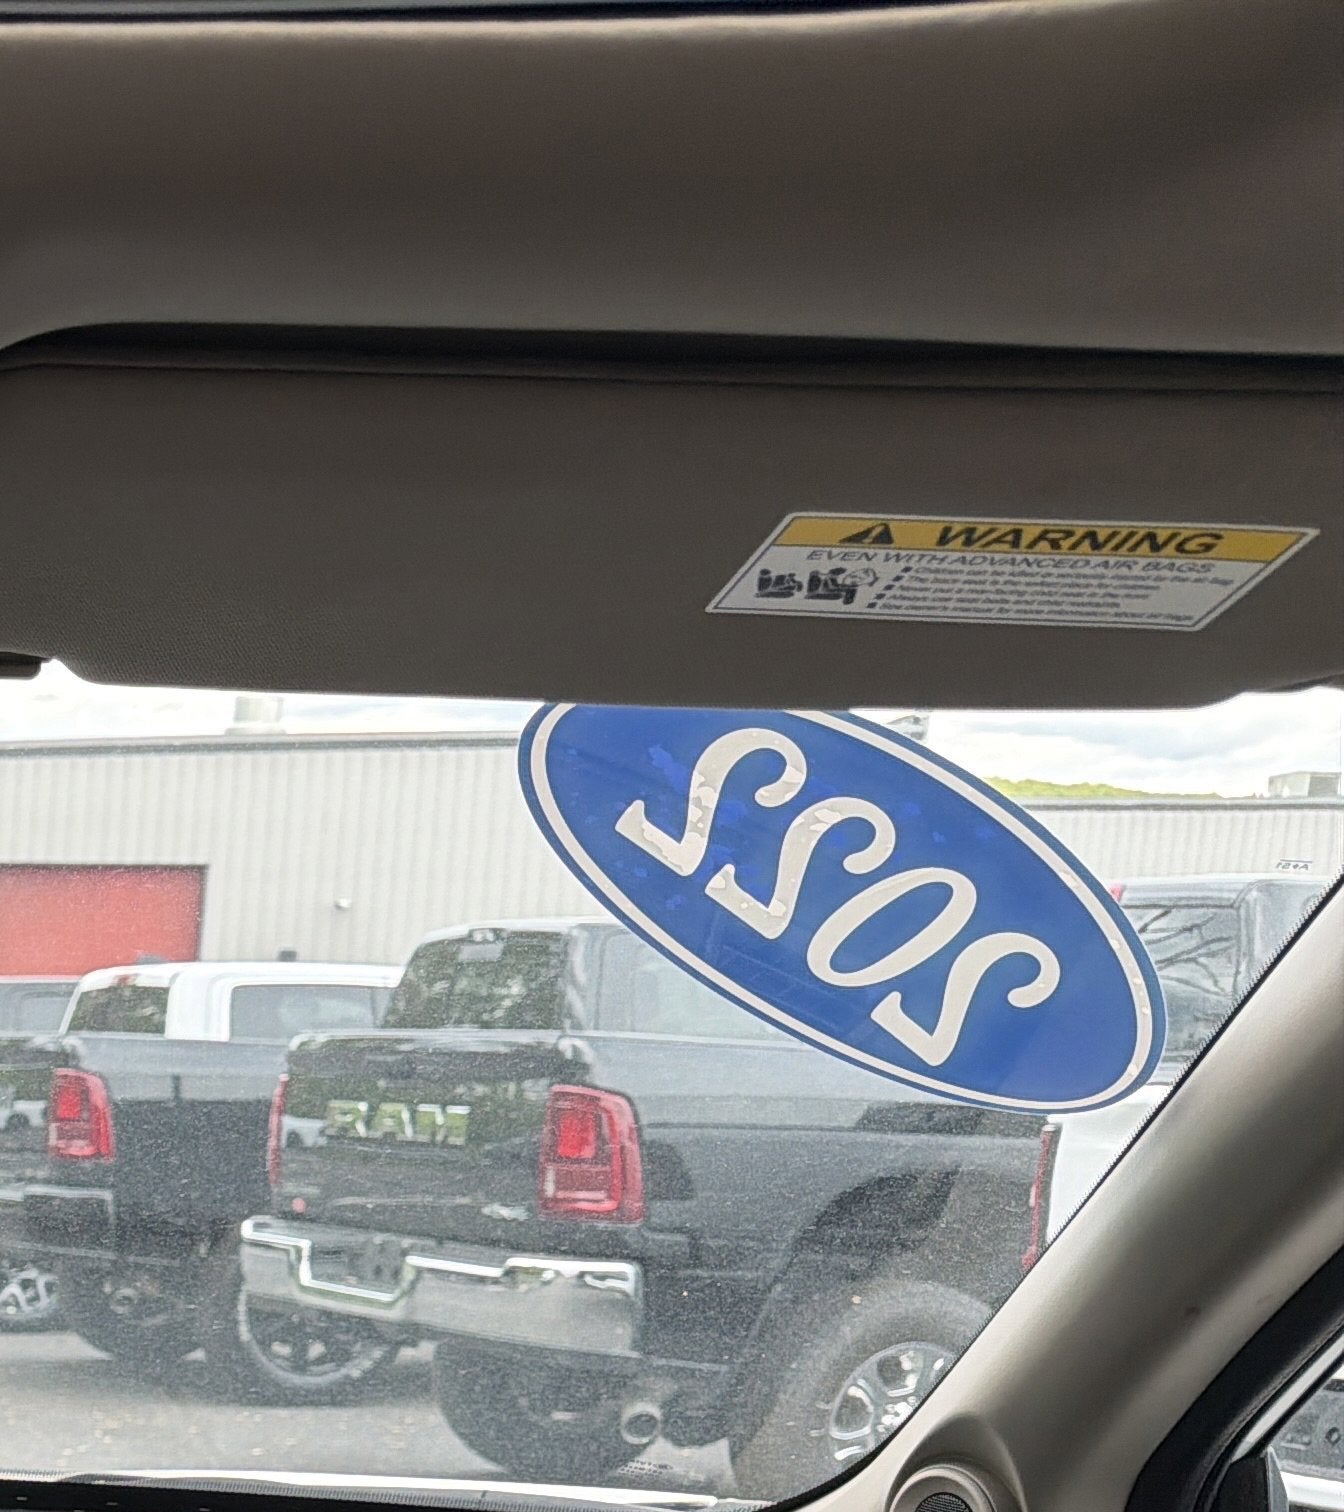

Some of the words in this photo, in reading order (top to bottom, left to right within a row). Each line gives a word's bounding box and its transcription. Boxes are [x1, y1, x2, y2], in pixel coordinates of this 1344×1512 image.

[934, 522, 1225, 555] WARNING
[805, 550, 882, 562] EVEN
[882, 551, 954, 566] WITH
[953, 554, 1100, 570] ADVANCED
[1094, 558, 1140, 571] AIR
[1141, 560, 1215, 574] BAGS
[325, 1100, 472, 1145] RAM
